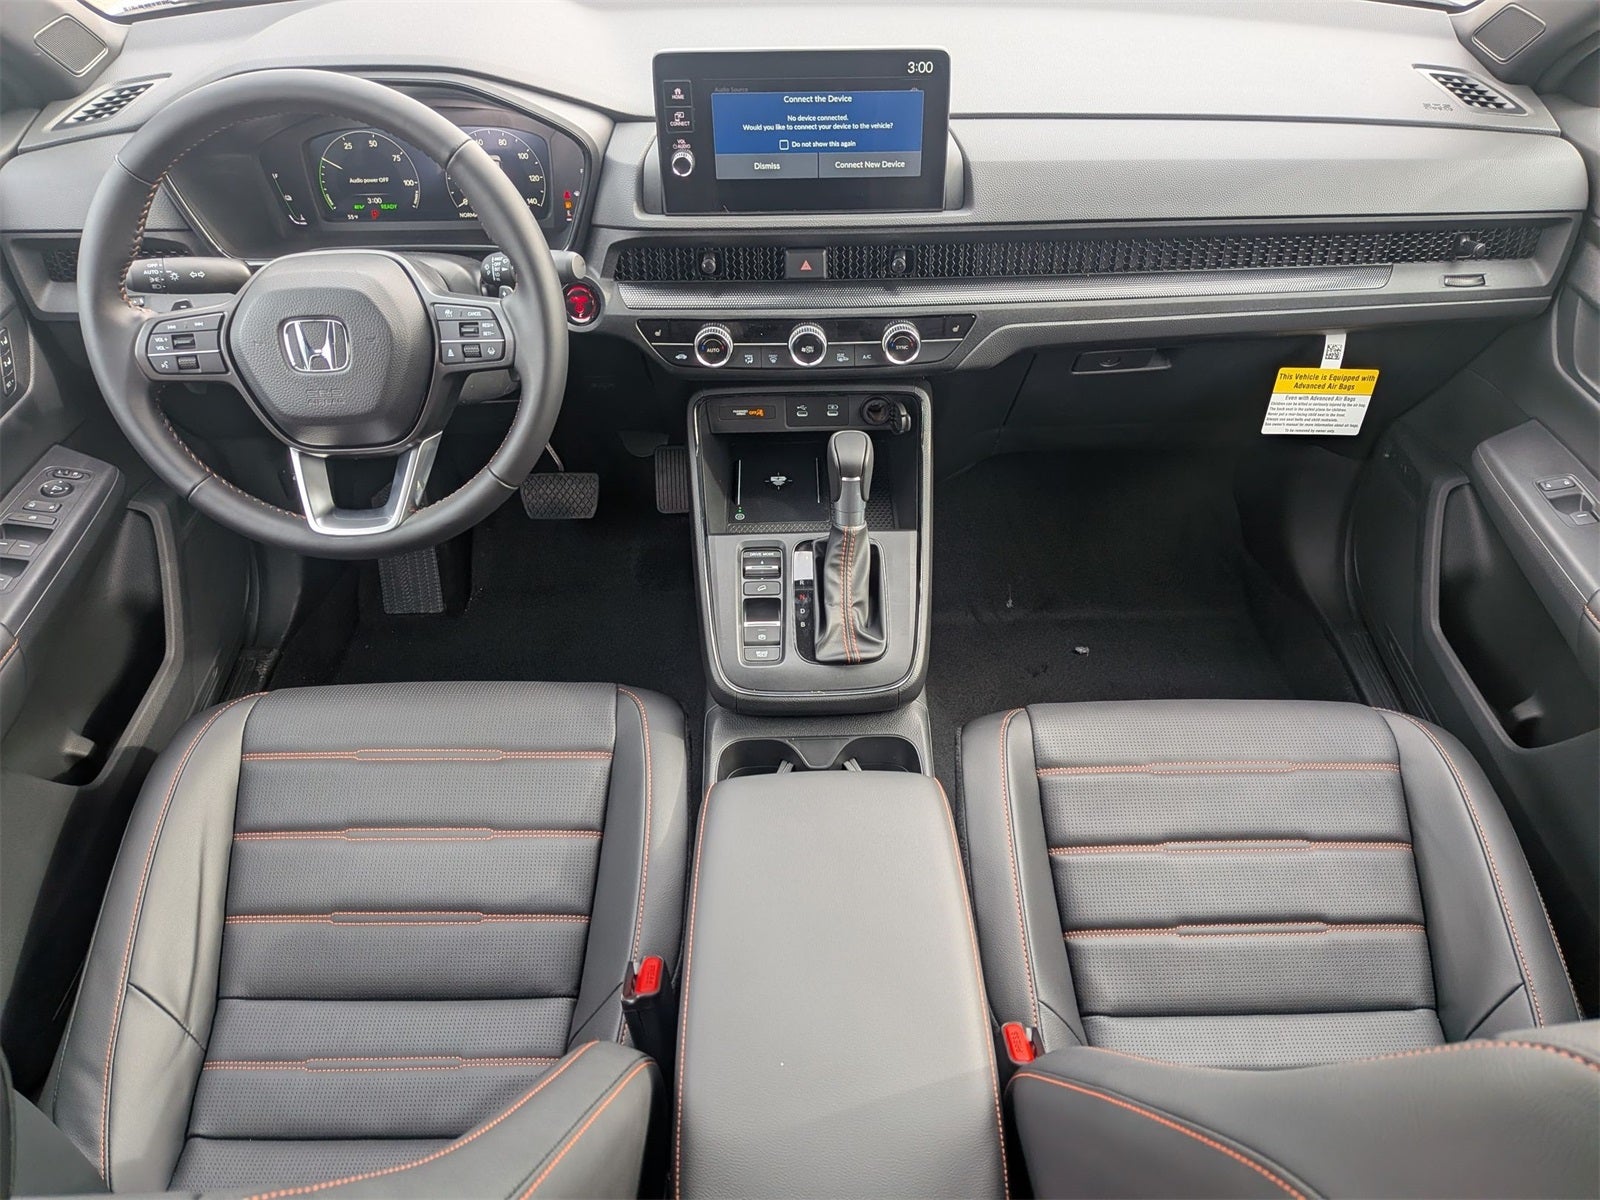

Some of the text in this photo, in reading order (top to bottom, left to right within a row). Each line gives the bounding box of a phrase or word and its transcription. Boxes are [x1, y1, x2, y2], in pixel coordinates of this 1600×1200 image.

[907, 61, 934, 74] 3:00
[783, 95, 814, 103] Connect
[828, 95, 853, 103] Device
[343, 142, 353, 150] 25
[368, 140, 378, 148] 50
[840, 141, 857, 149] again
[391, 154, 401, 162] 75
[753, 162, 781, 170] Dismiss
[834, 160, 906, 169] Connect New Device
[367, 197, 383, 205] 3:00
[1294, 373, 1320, 381] Vehicle
[1328, 374, 1361, 383] Equipped
[1293, 382, 1326, 390] Advanced
[1339, 384, 1356, 392] Bags
